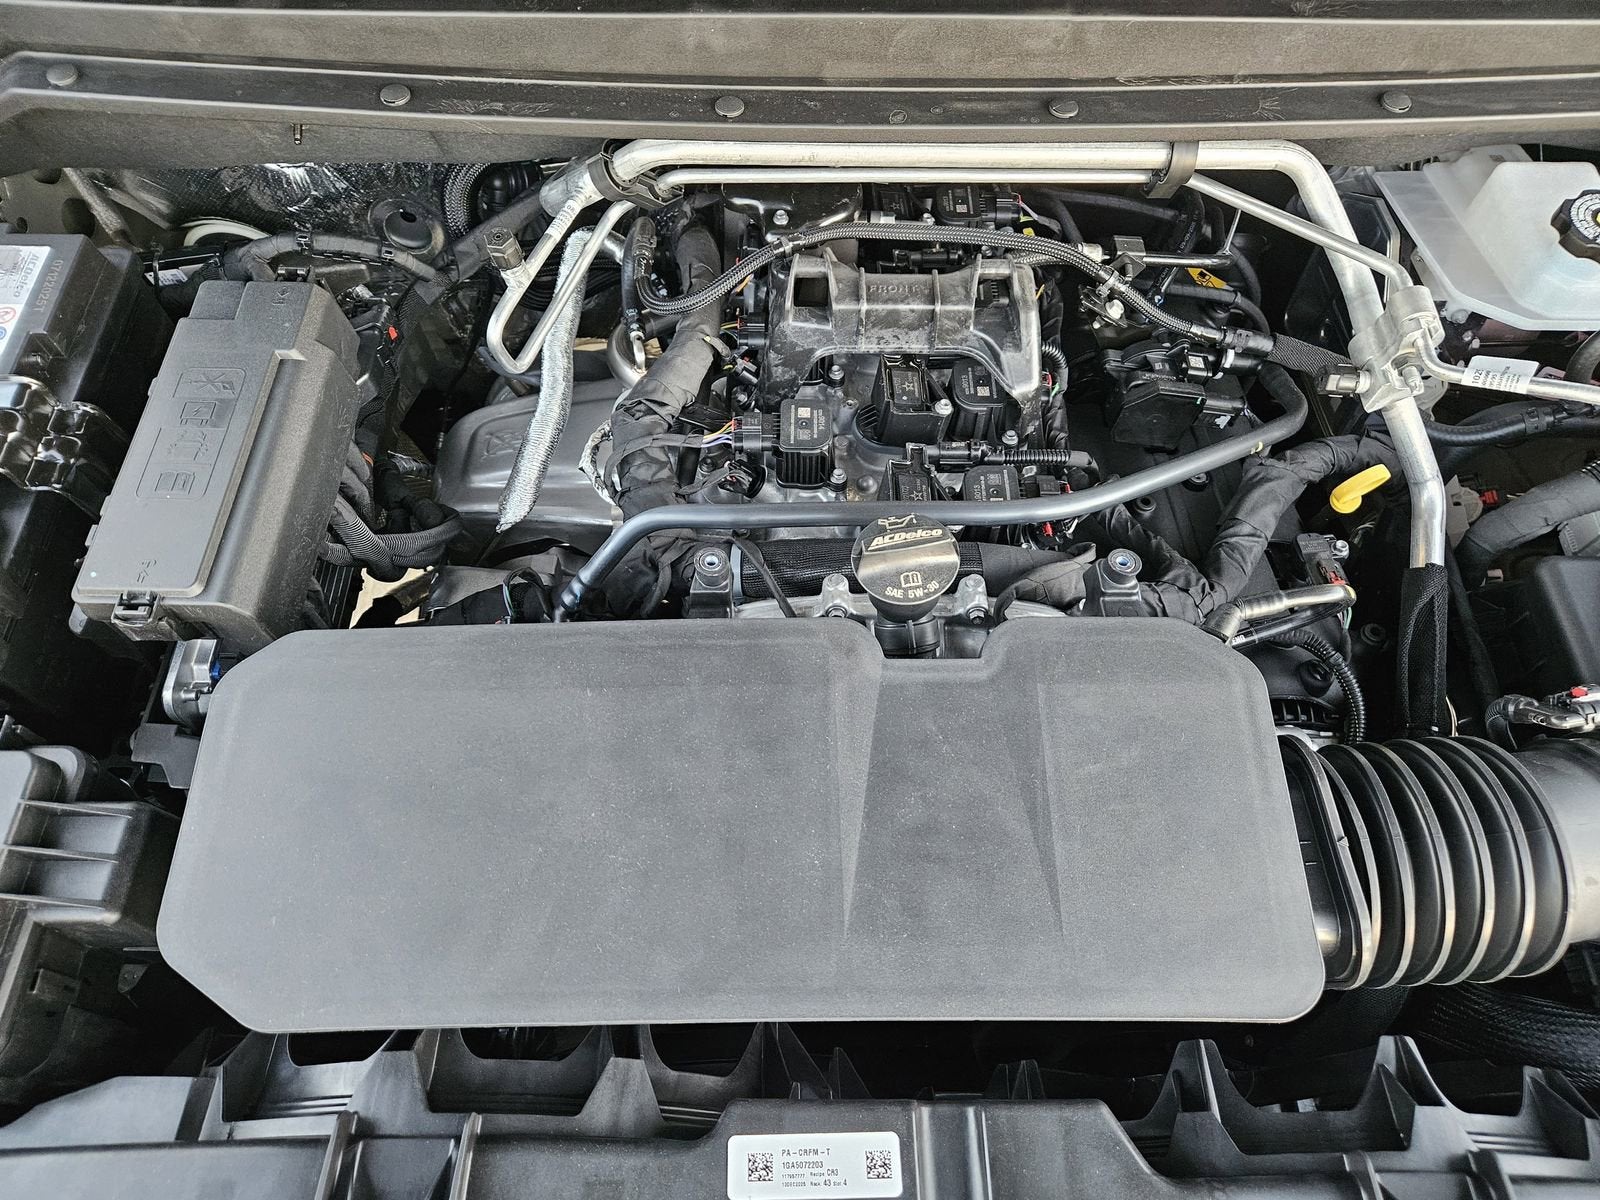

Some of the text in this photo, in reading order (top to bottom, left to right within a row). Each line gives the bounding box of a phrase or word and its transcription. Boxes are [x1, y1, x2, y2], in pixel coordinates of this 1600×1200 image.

[33, 259, 64, 312] 07122025T
[868, 529, 943, 550] ACDelco
[885, 580, 940, 598] SAE 5W-30
